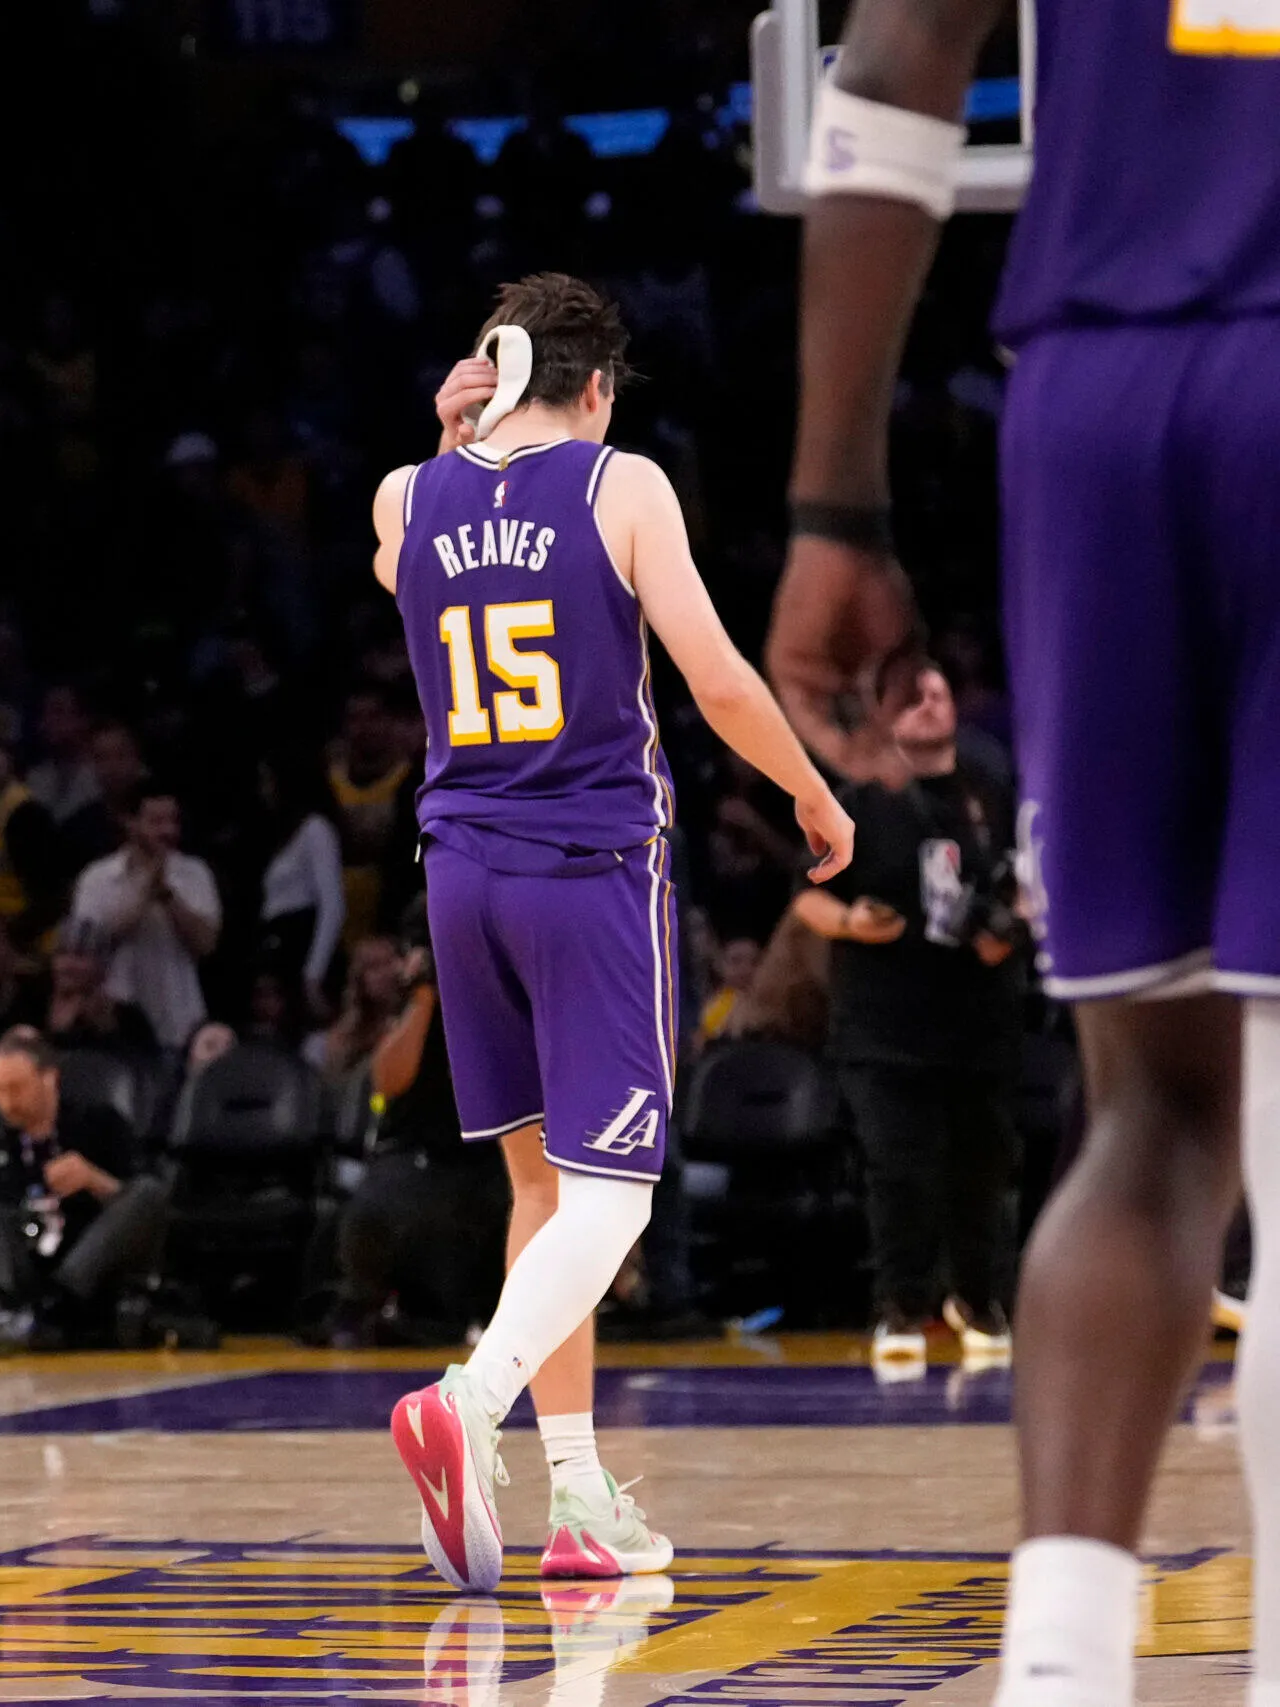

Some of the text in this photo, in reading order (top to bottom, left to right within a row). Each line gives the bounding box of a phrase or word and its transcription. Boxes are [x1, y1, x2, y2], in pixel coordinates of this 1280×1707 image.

[433, 518, 556, 579] REAVES
[439, 600, 565, 746] 15
[582, 1086, 658, 1156] LA
